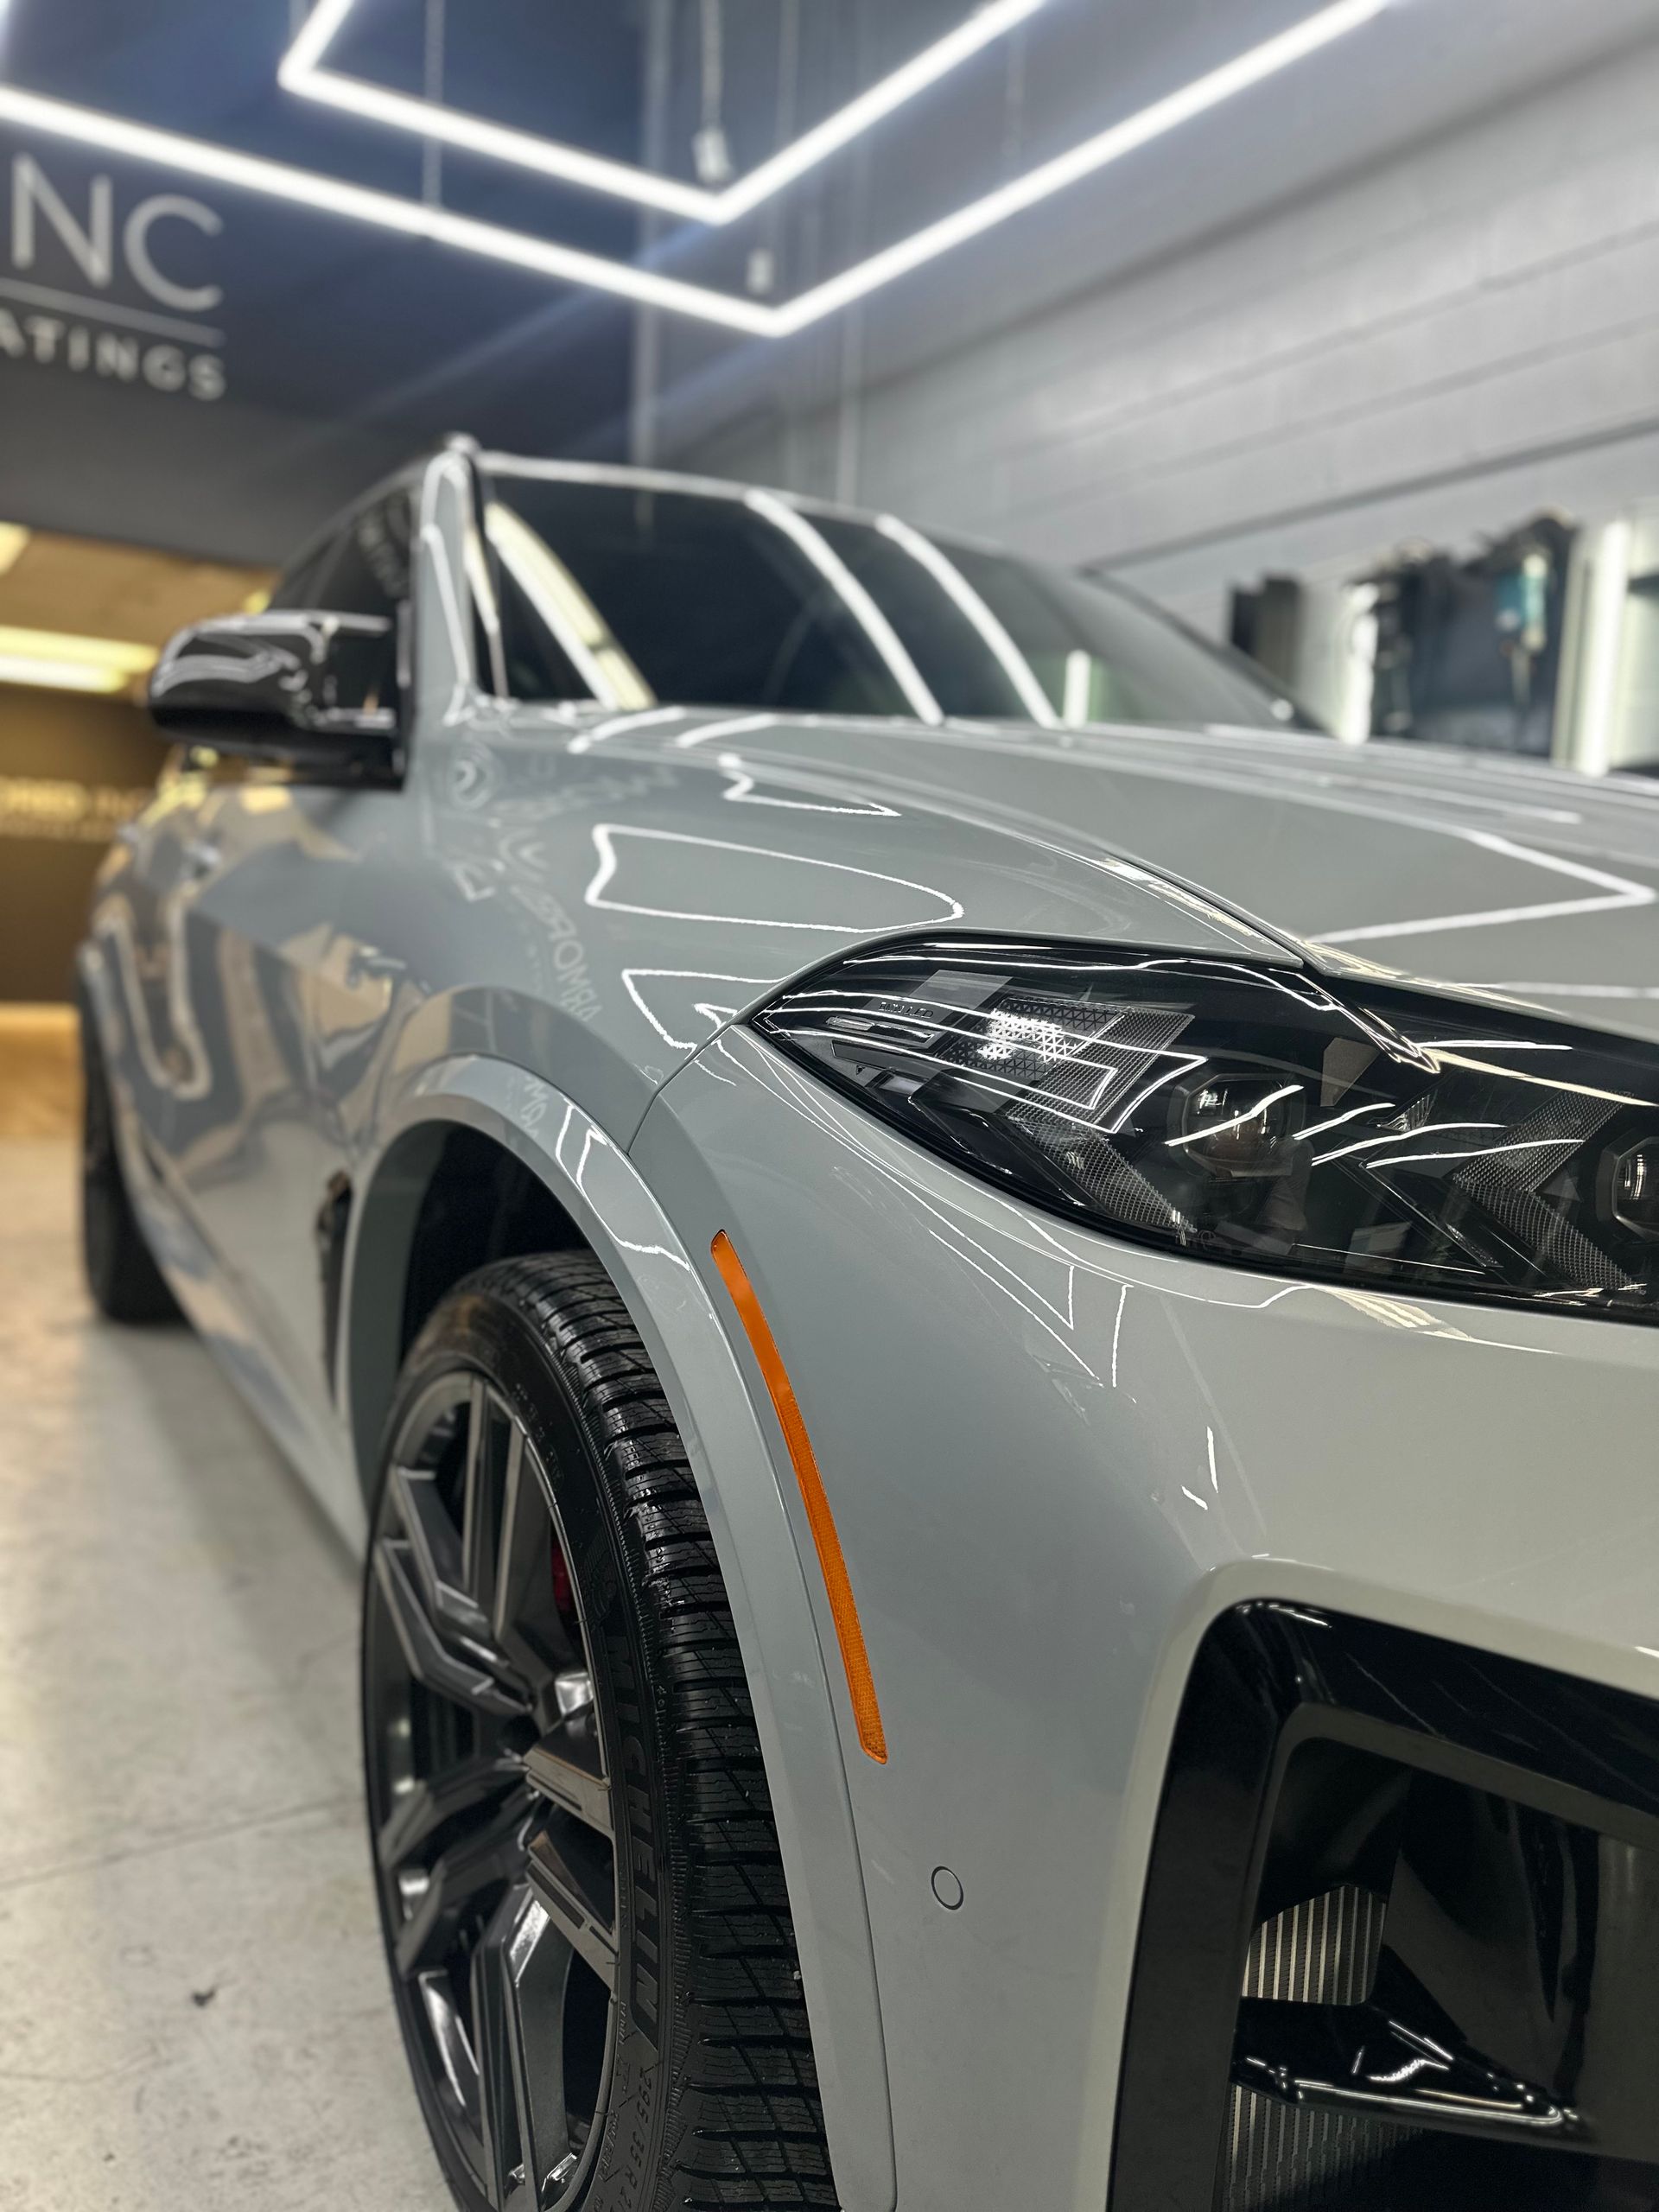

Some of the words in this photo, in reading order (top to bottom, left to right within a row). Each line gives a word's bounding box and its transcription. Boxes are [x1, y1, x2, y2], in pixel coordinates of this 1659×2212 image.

[12, 153, 222, 312] NC
[906, 1006, 934, 1019] LED
[606, 1636, 658, 2024] MICHELIN
